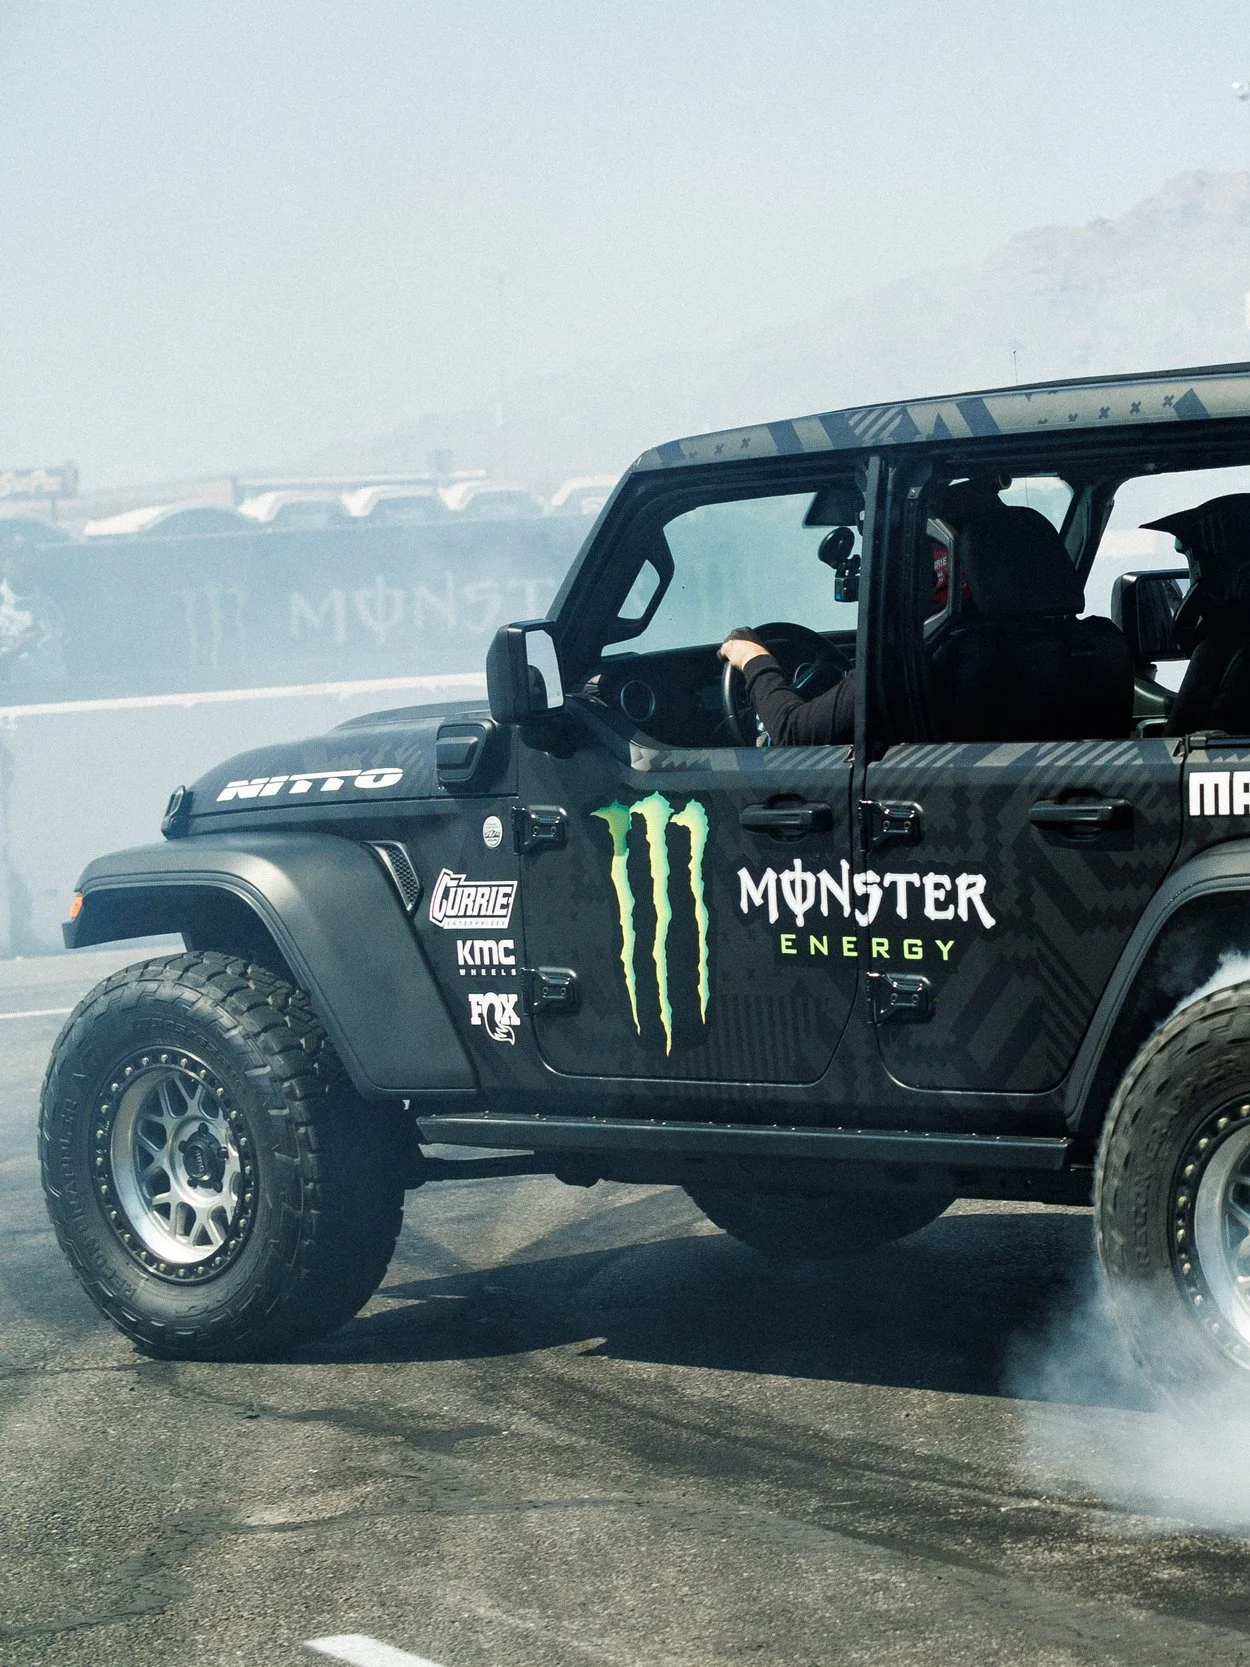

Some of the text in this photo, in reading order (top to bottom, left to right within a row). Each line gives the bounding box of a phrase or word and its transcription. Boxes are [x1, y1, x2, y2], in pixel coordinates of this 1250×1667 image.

[289, 572, 558, 646] MONST
[216, 767, 404, 802] NITTO
[431, 870, 515, 923] CURRIE
[737, 858, 996, 930] MONSTER
[456, 939, 516, 966] KMC
[780, 933, 956, 961] ENERGY
[459, 968, 517, 976] WHEELS
[468, 992, 521, 1045] FOX
